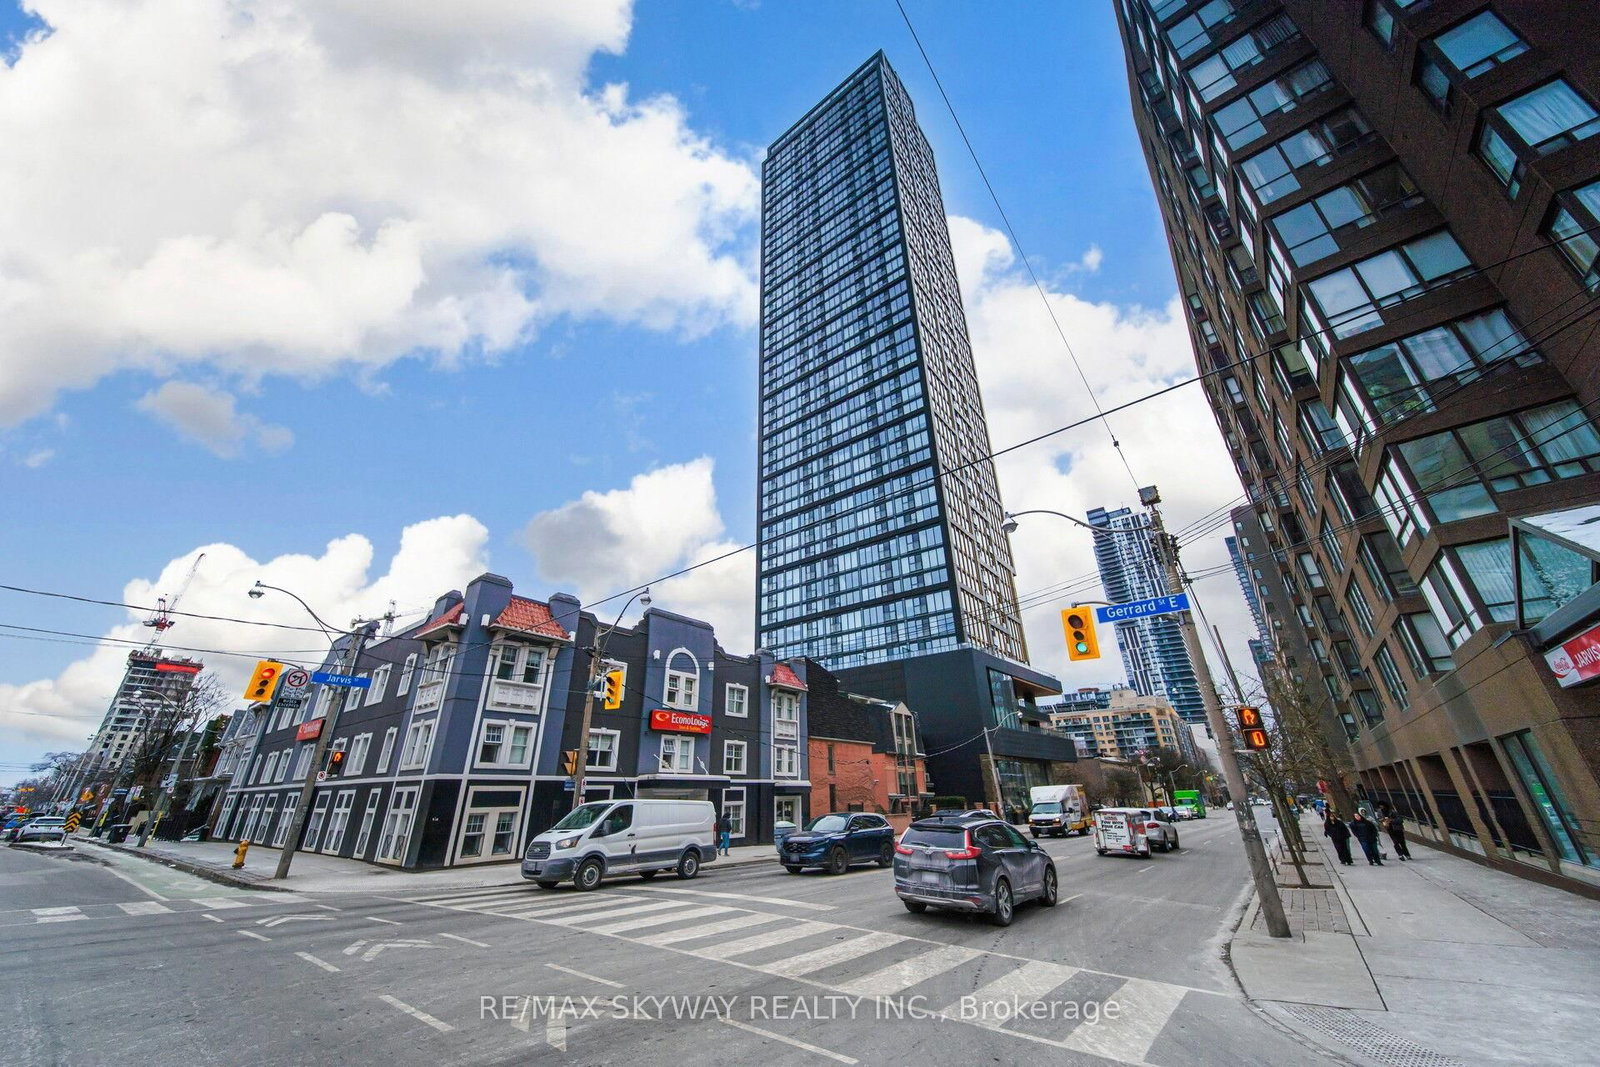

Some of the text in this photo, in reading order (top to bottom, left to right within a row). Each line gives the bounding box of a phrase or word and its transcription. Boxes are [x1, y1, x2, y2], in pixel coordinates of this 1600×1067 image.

[1106, 600, 1156, 619] Gerrard
[1168, 596, 1178, 608] E
[1574, 646, 1600, 668] JARVIS
[326, 674, 352, 685] Jarvis
